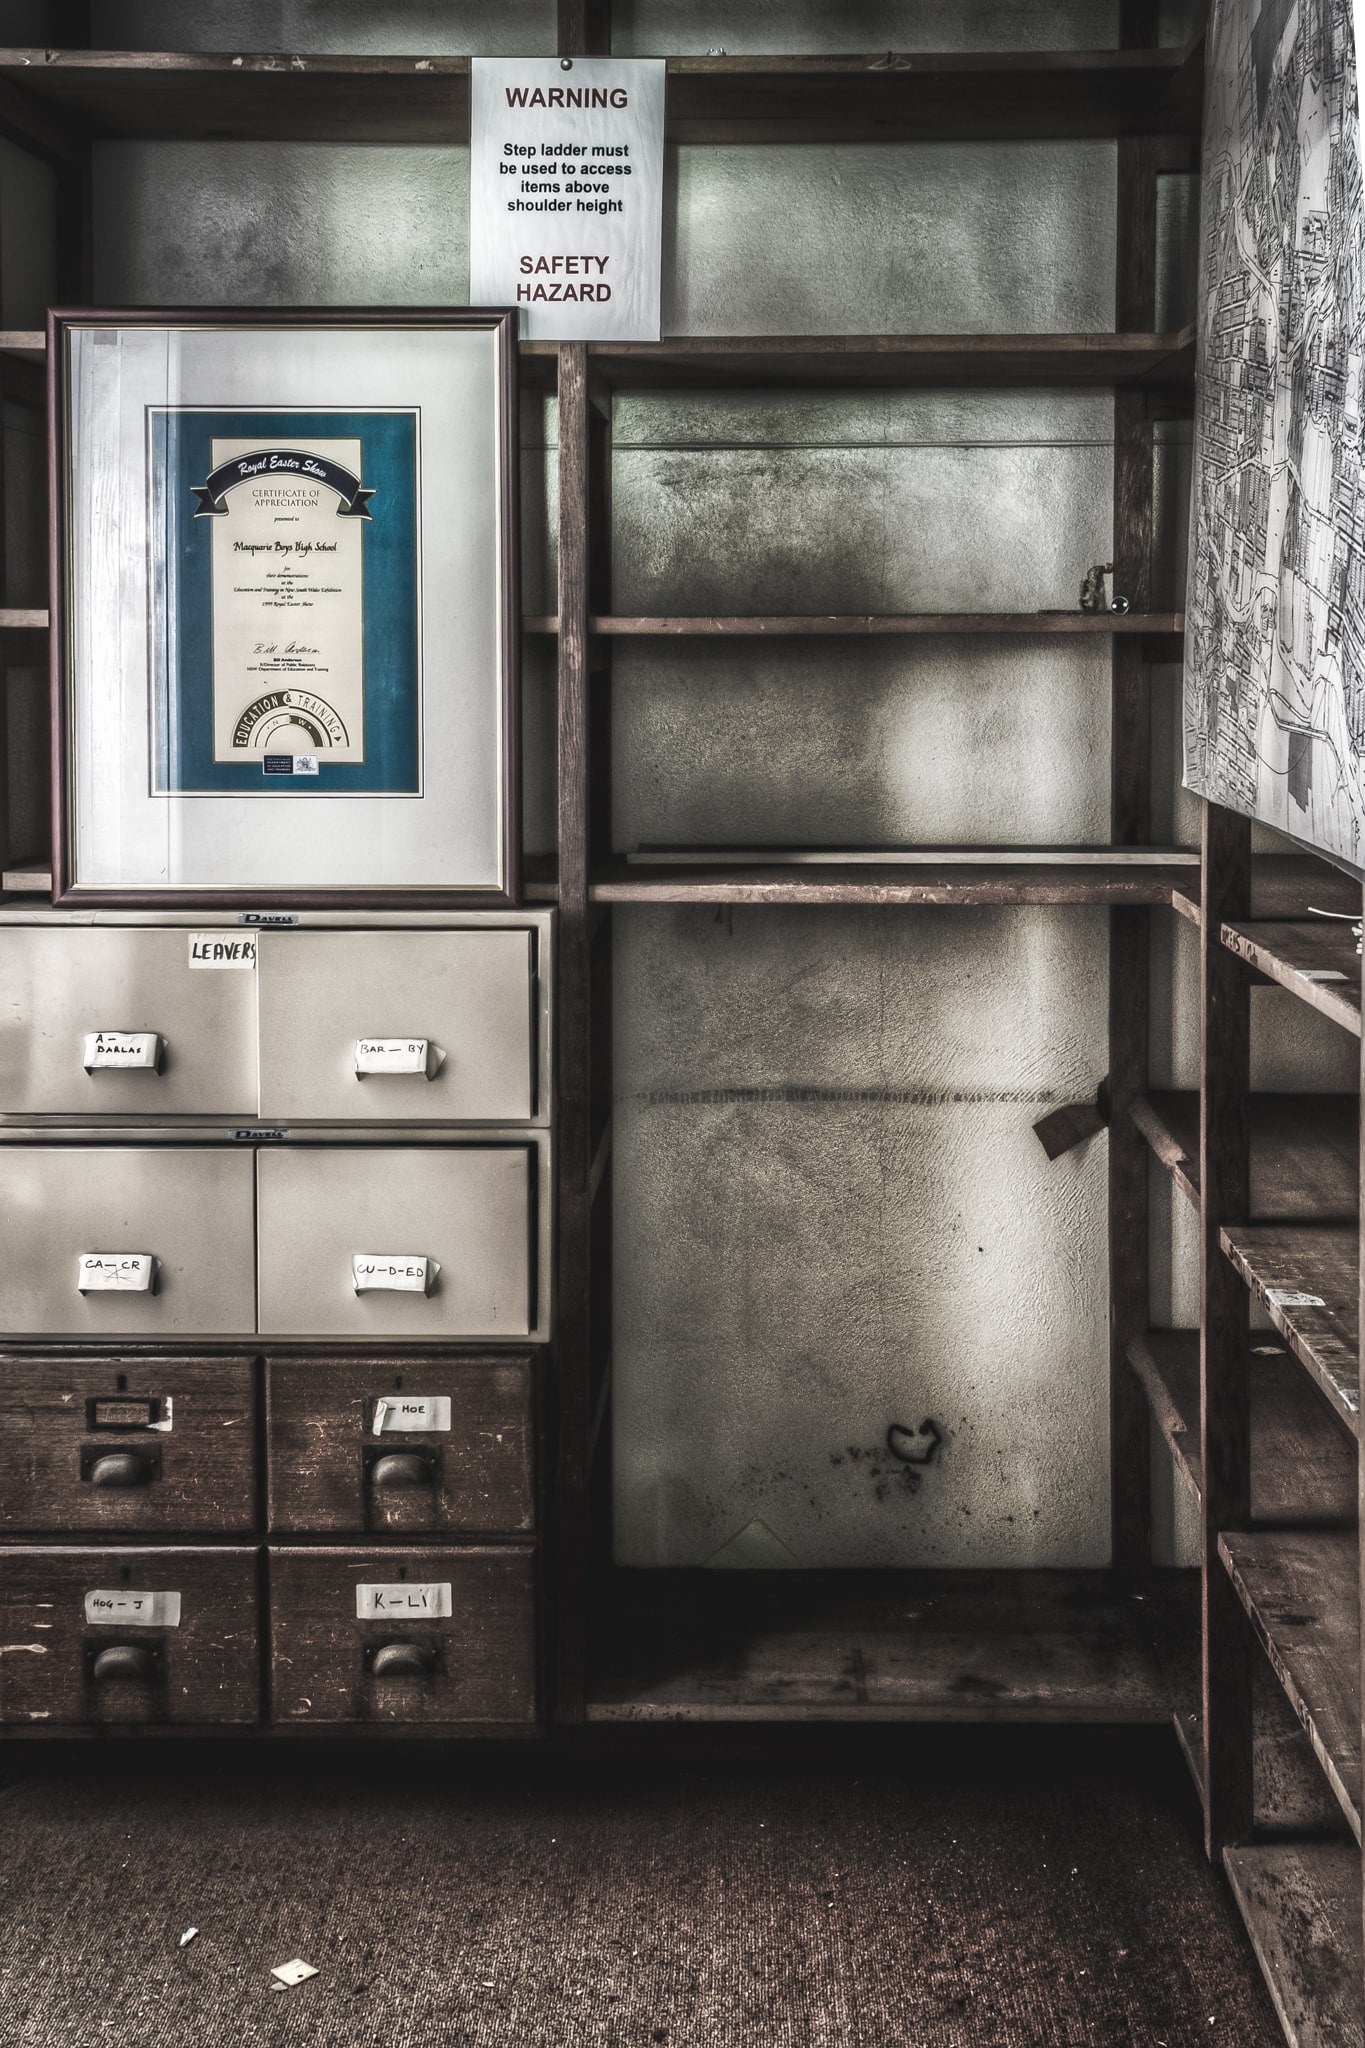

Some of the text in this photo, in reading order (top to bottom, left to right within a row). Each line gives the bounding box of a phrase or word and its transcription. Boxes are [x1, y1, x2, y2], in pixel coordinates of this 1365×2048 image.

[505, 87, 628, 108] WARNING
[503, 143, 629, 158] Step ladder must
[499, 162, 632, 175] be used to access
[521, 180, 610, 194] items above
[507, 199, 623, 215] shoulder height
[519, 256, 610, 275] SAFETY
[516, 283, 612, 302] HAZARD
[238, 455, 327, 478] Royal Easter Show
[252, 489, 321, 498] CERTIFICATE OF
[254, 499, 319, 507] APPRECIATION
[233, 540, 338, 557] Macquarie Boys High School
[236, 694, 340, 745] EDUCATION & TRAINING
[360, 1044, 385, 1054] BAR
[408, 1044, 424, 1054] BY
[402, 1405, 426, 1414] HOE
[93, 1599, 113, 1609] HOG
[375, 1592, 385, 1609] K
